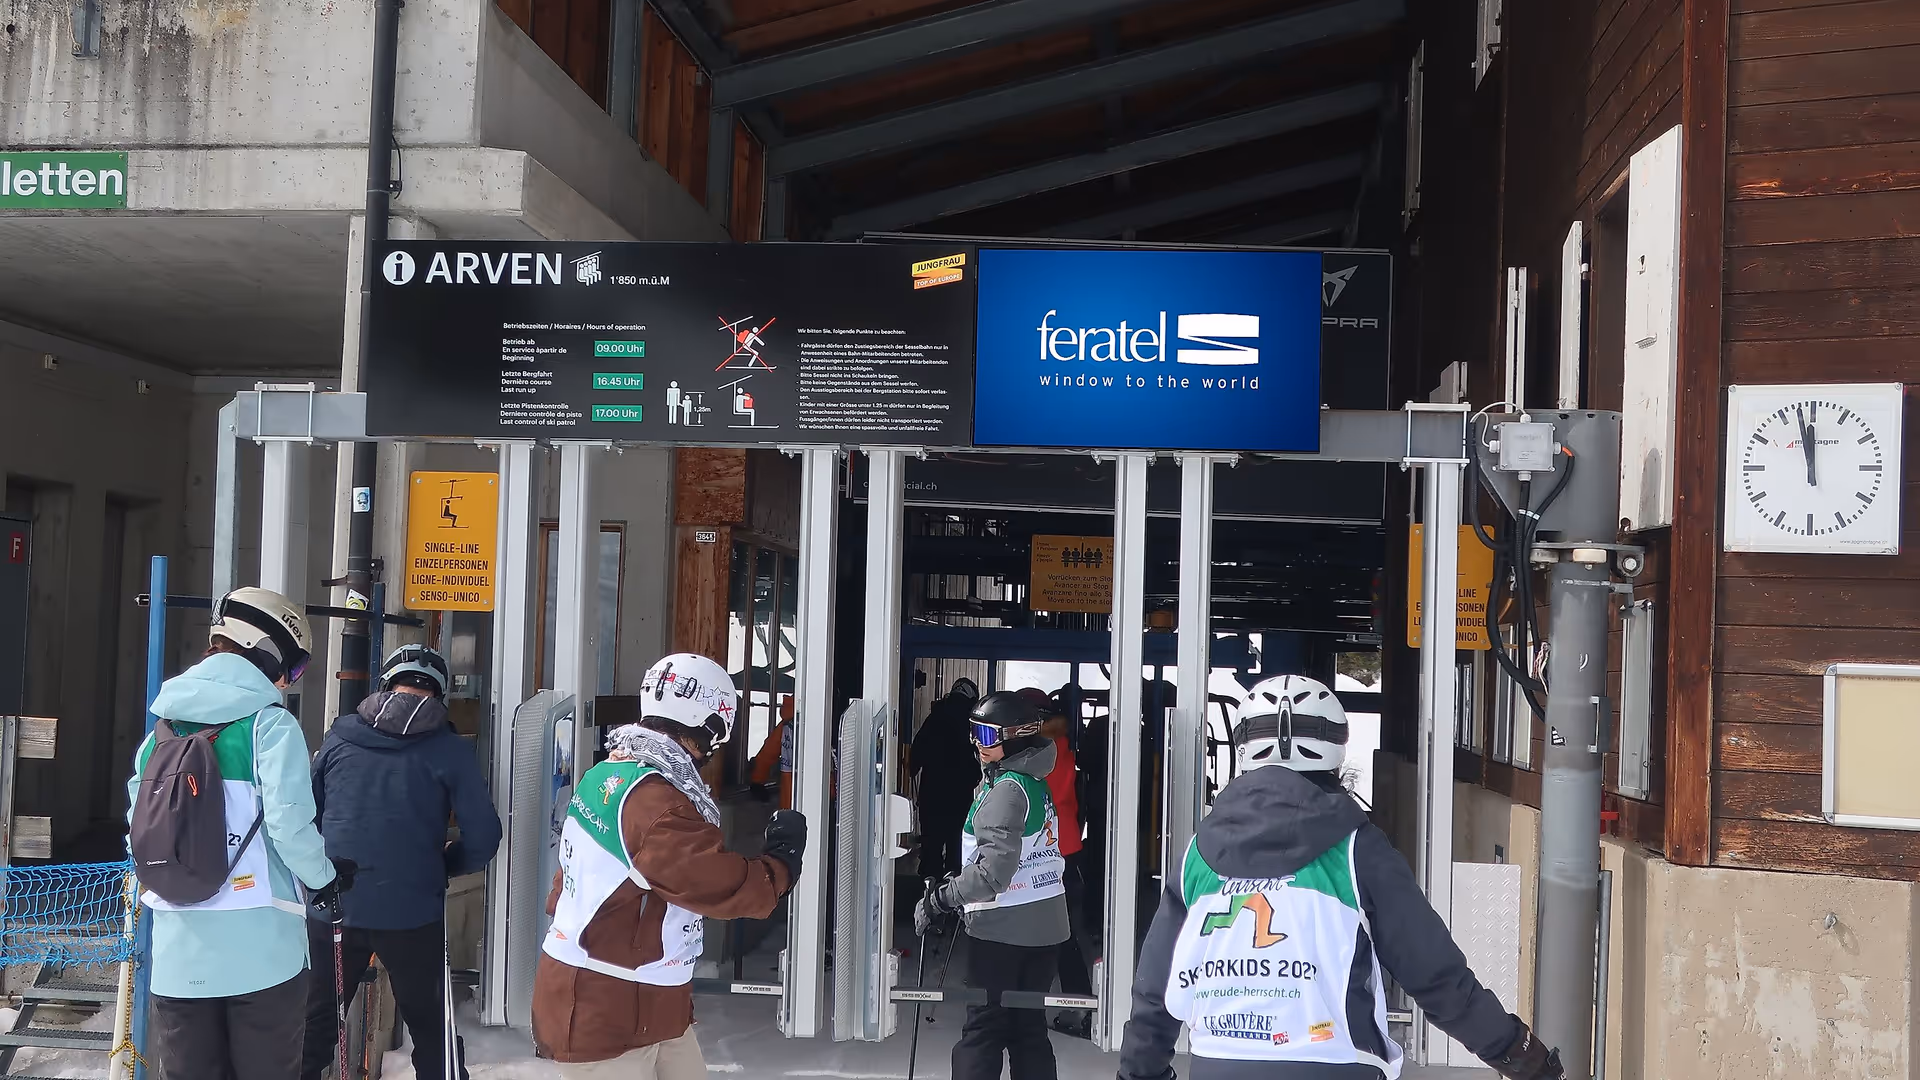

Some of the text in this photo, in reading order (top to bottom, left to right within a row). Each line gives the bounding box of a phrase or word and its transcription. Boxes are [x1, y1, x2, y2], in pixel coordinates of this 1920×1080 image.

[2, 161, 123, 196] letten
[425, 252, 562, 285] ARVEN
[916, 256, 961, 272] JUNGFRAU
[938, 273, 960, 283] EUROPE
[1036, 309, 1167, 363] feratel
[596, 344, 644, 353] 09.00 Uhr
[502, 354, 535, 363] Beginning
[596, 377, 641, 386] 16.45 Uhr
[1039, 373, 1260, 390] window to the world
[521, 402, 569, 410] Pistenkontrolle
[595, 408, 639, 418] 17.00 Uhr
[556, 419, 576, 427] patrol
[12, 537, 21, 558] F
[424, 542, 480, 554] SINGLE-LINE
[414, 557, 489, 571] EINZELPERSONEN
[411, 574, 490, 587] LIGNE-INDIVIDUEL
[420, 590, 480, 603] SENSO-UNICO
[281, 614, 304, 641] uvex
[1218, 1011, 1273, 1031] GRUYÈRE
